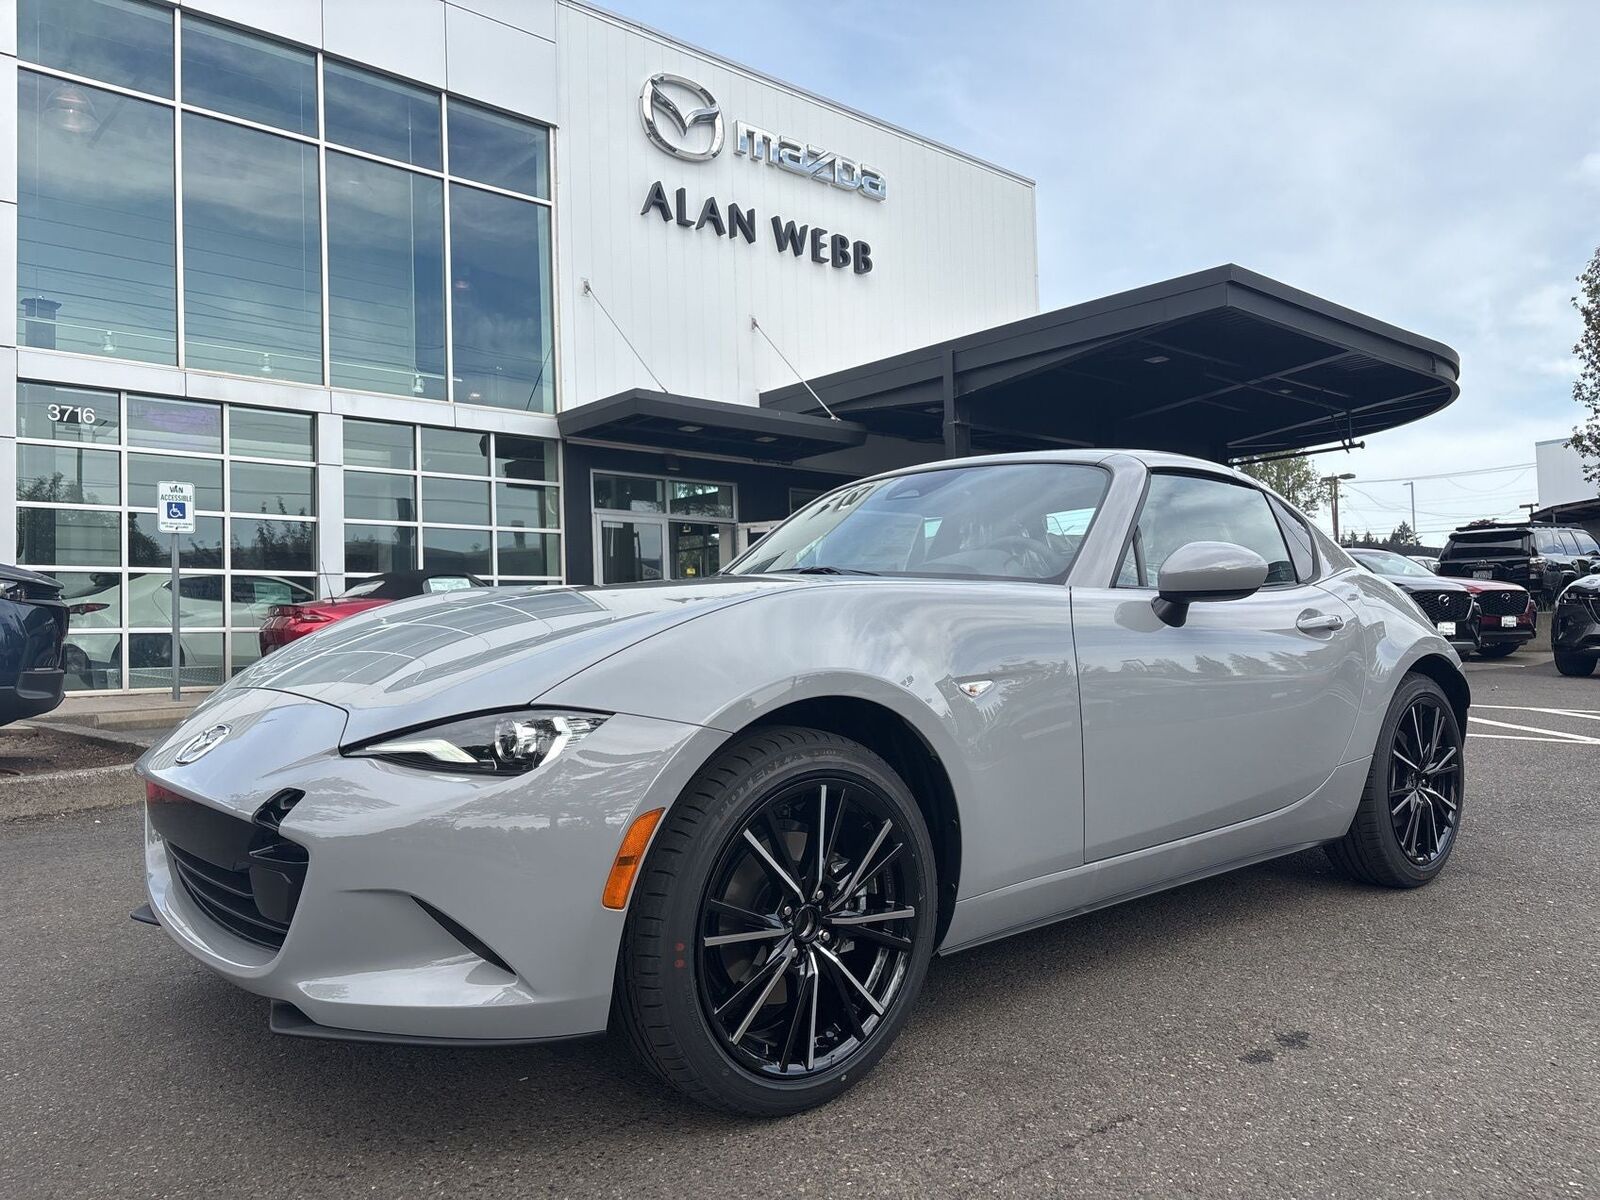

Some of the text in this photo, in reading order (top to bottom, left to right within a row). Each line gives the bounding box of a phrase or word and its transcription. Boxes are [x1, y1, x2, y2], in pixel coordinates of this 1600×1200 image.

[640, 180, 873, 275] ALAN WEBB
[47, 404, 96, 424] 3716
[169, 485, 184, 494] VAN
[160, 494, 192, 502] ACCESSIBLE
